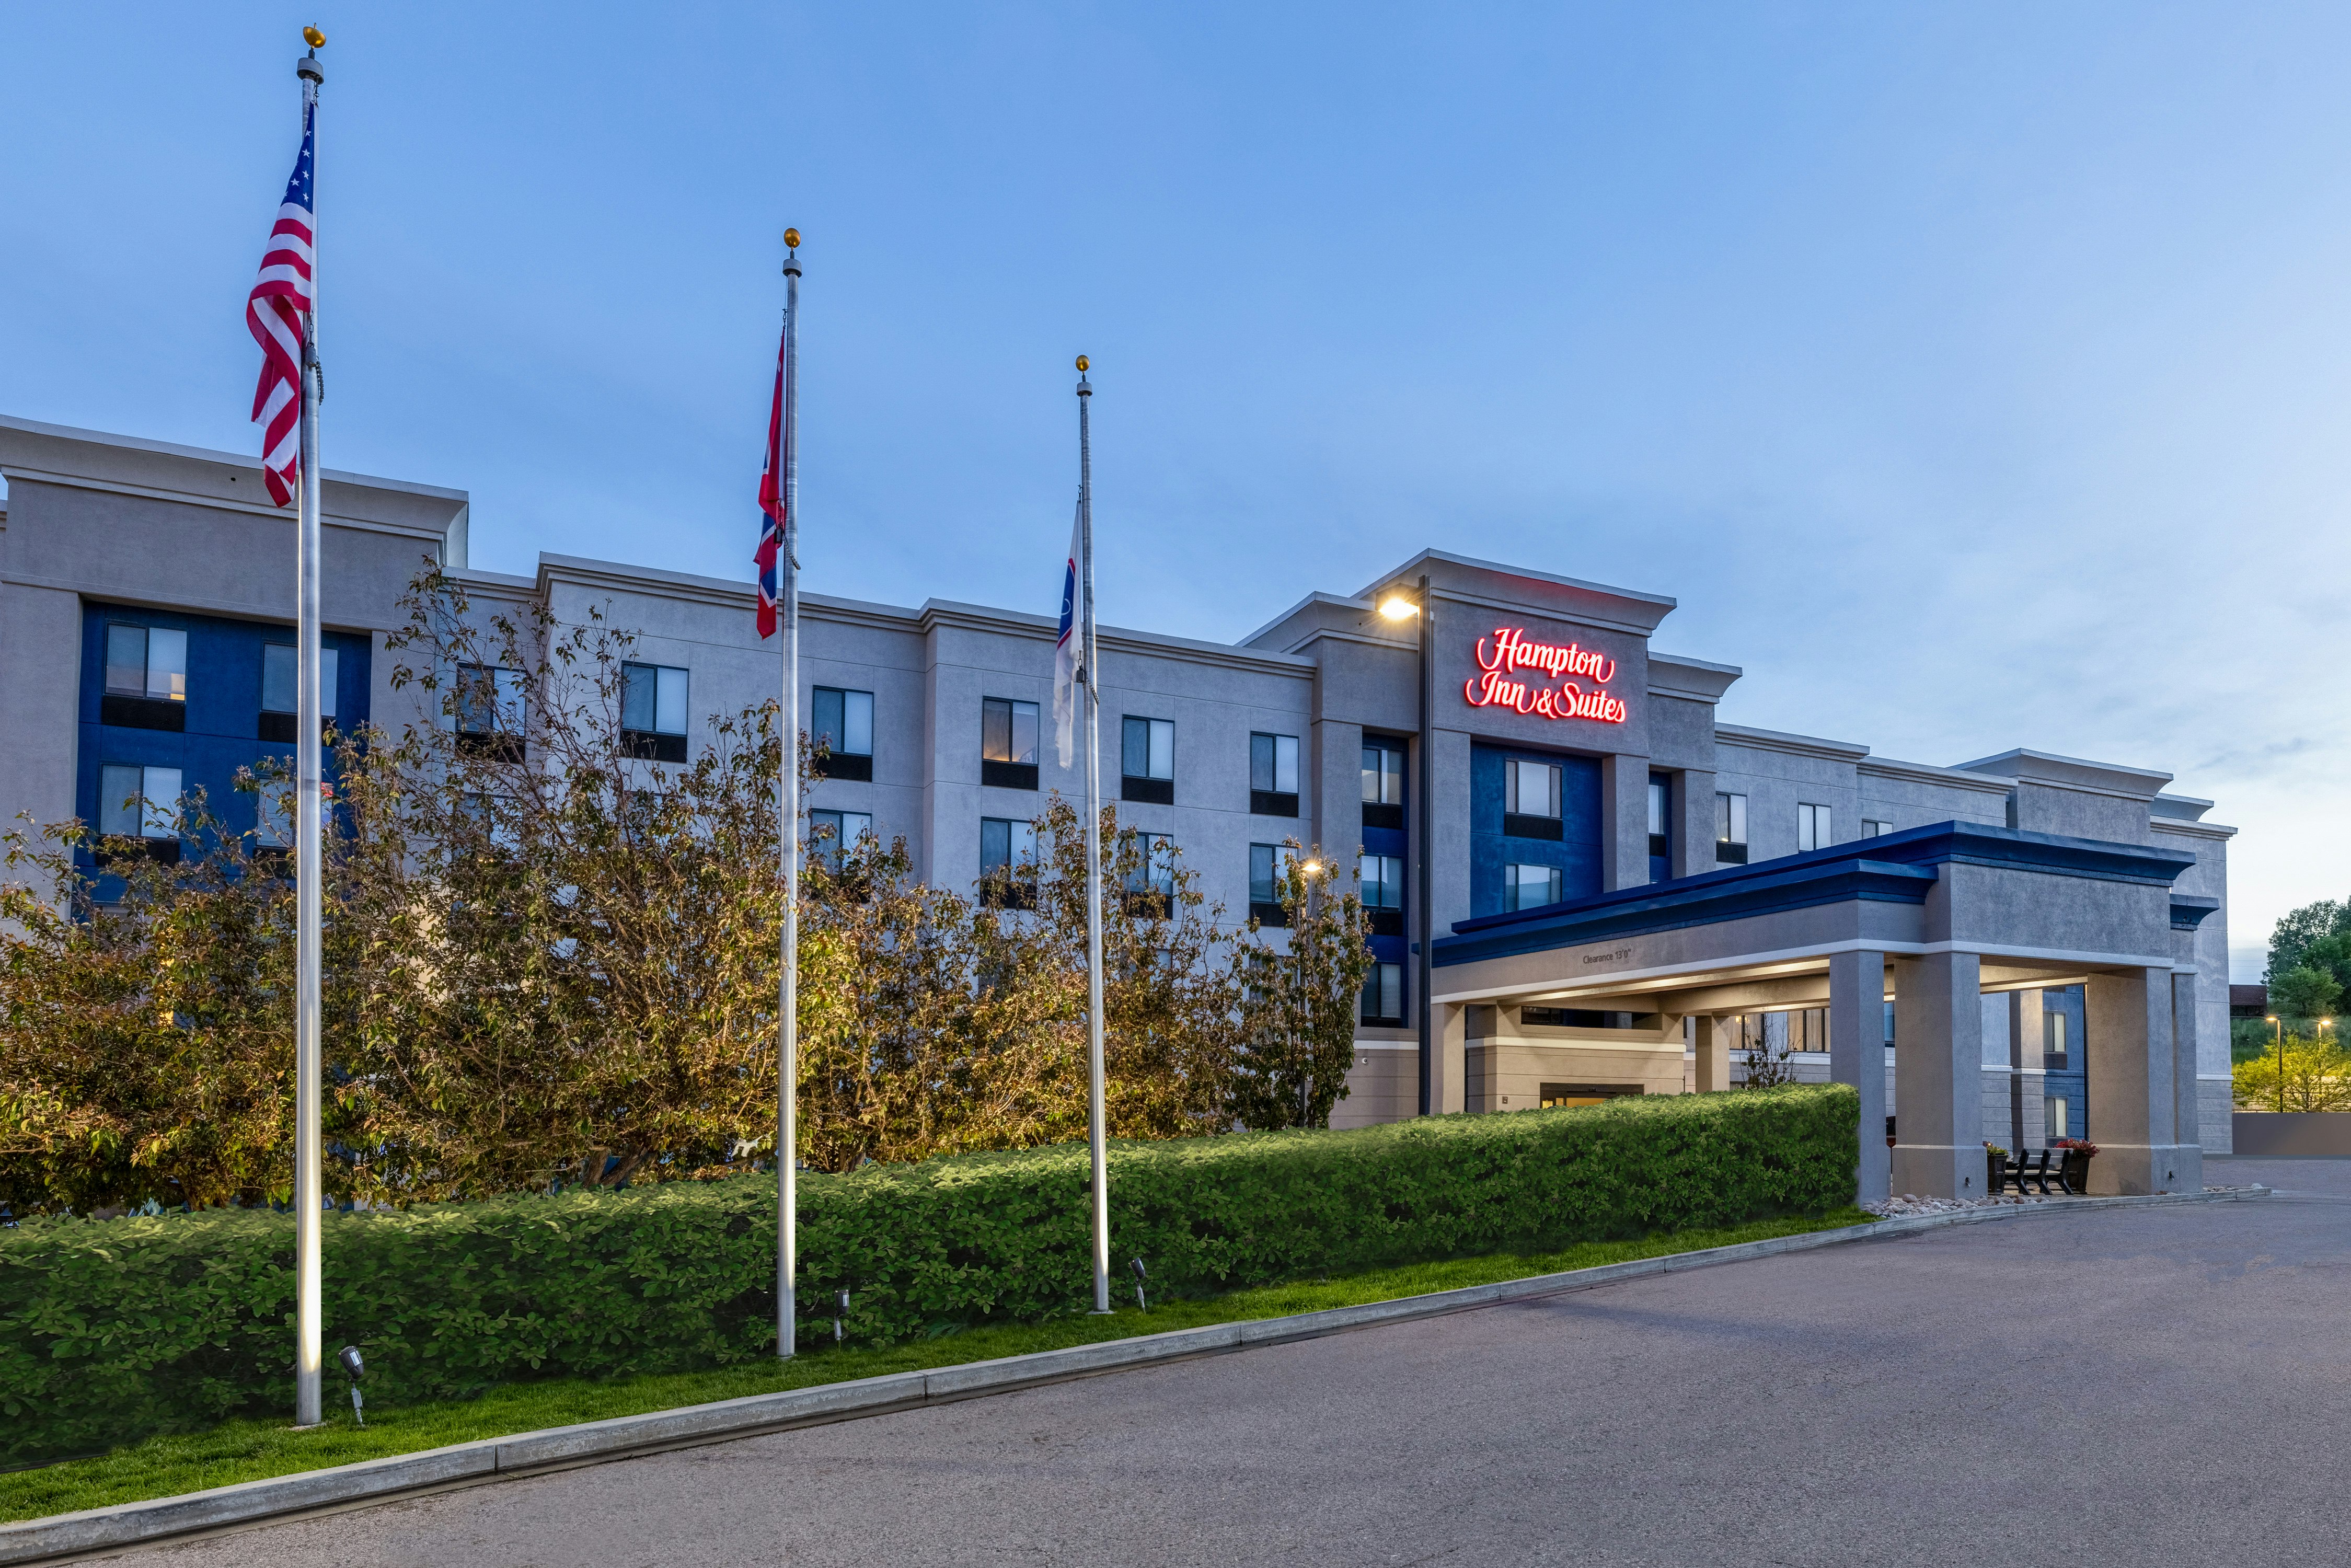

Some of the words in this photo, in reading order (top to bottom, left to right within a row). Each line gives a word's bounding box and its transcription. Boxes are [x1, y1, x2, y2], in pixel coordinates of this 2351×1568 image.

[1477, 628, 1615, 683] Hampton
[1465, 672, 1537, 714] Inn
[1536, 688, 1558, 719] &
[1553, 682, 1626, 722] Suites
[1583, 953, 1614, 964] Clearance
